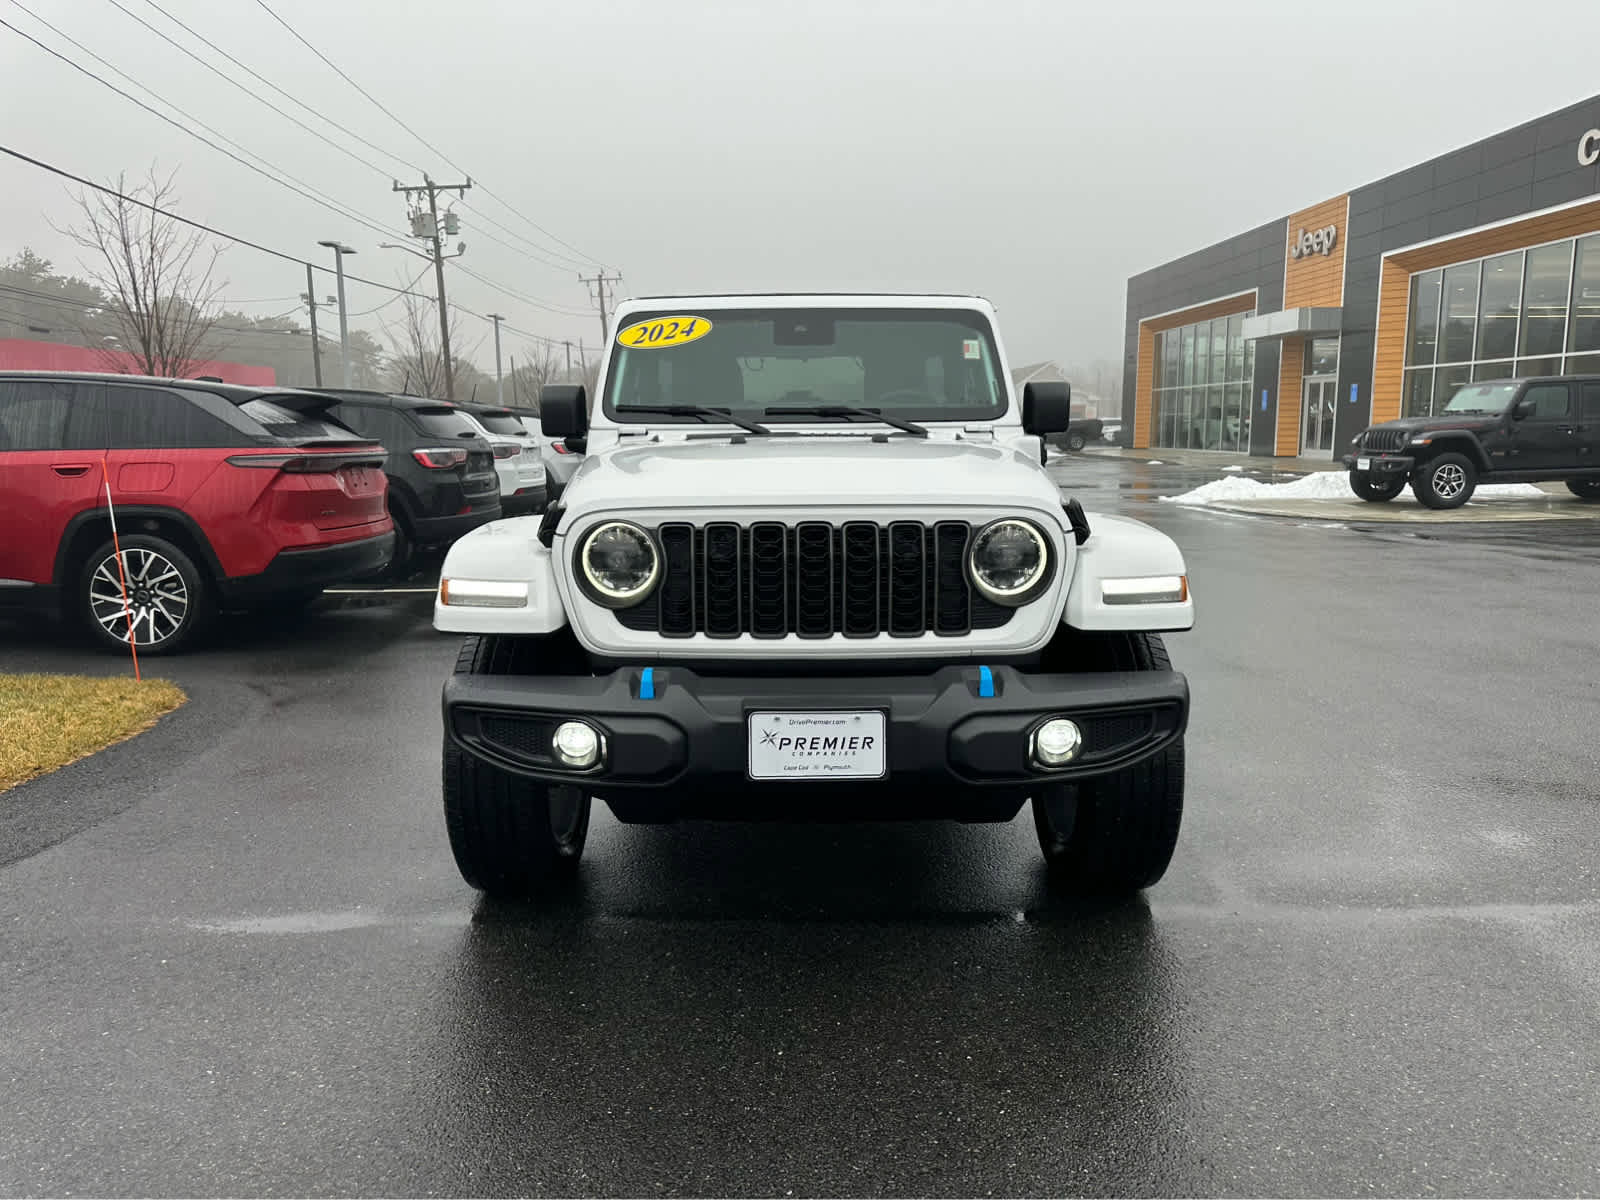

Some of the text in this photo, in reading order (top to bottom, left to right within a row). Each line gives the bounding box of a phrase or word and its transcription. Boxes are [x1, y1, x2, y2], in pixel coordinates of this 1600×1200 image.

[1291, 224, 1337, 259] Jeep
[631, 319, 698, 345] 2024
[778, 736, 875, 751] PREMIER
